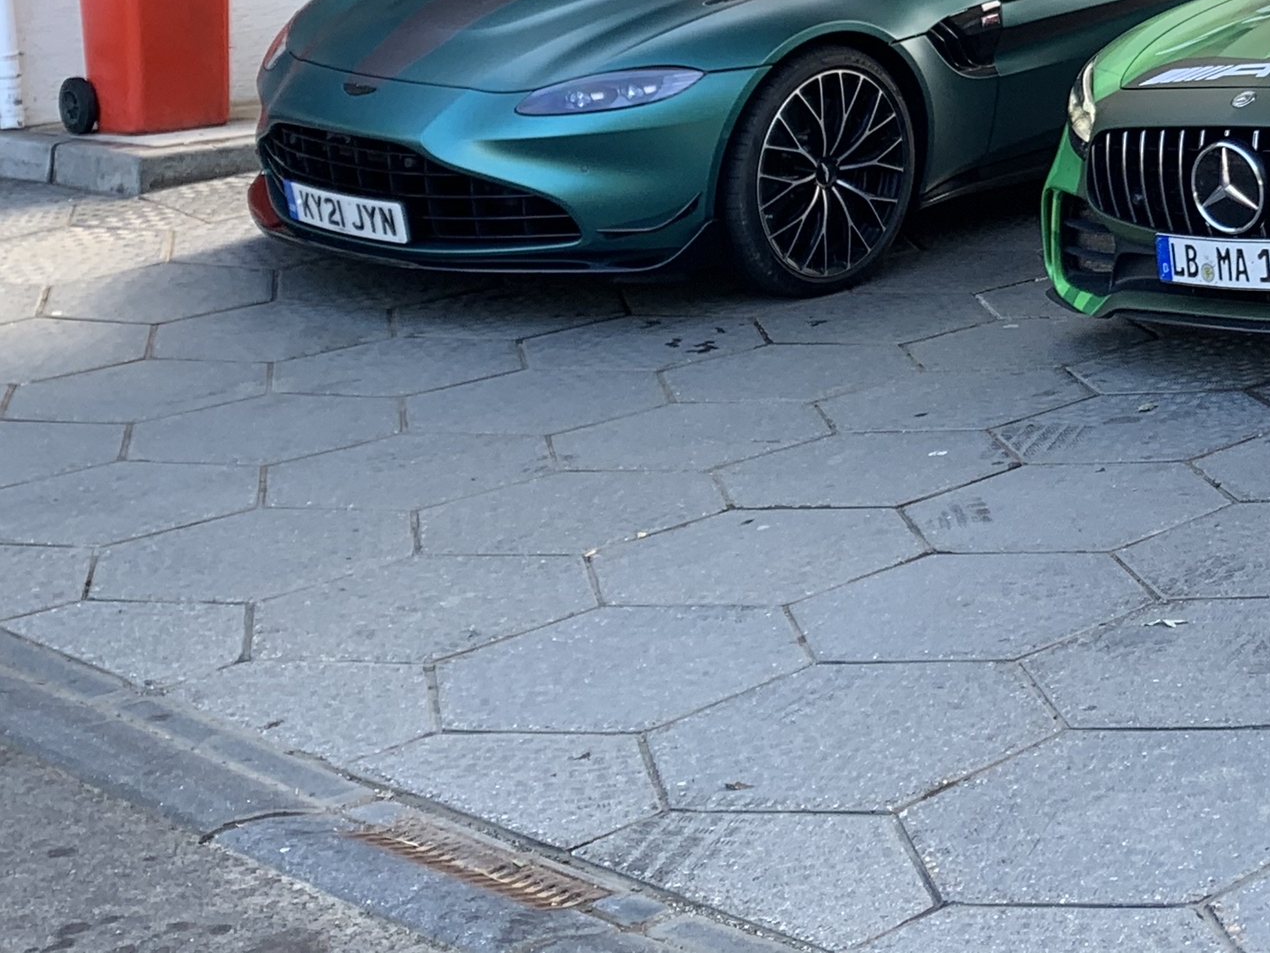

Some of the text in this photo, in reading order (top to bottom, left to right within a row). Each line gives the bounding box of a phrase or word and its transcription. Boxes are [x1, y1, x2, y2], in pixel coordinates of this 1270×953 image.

[299, 190, 398, 236] KY21 JYN
[1171, 242, 1199, 278] LB
[1216, 246, 1250, 282] MA
